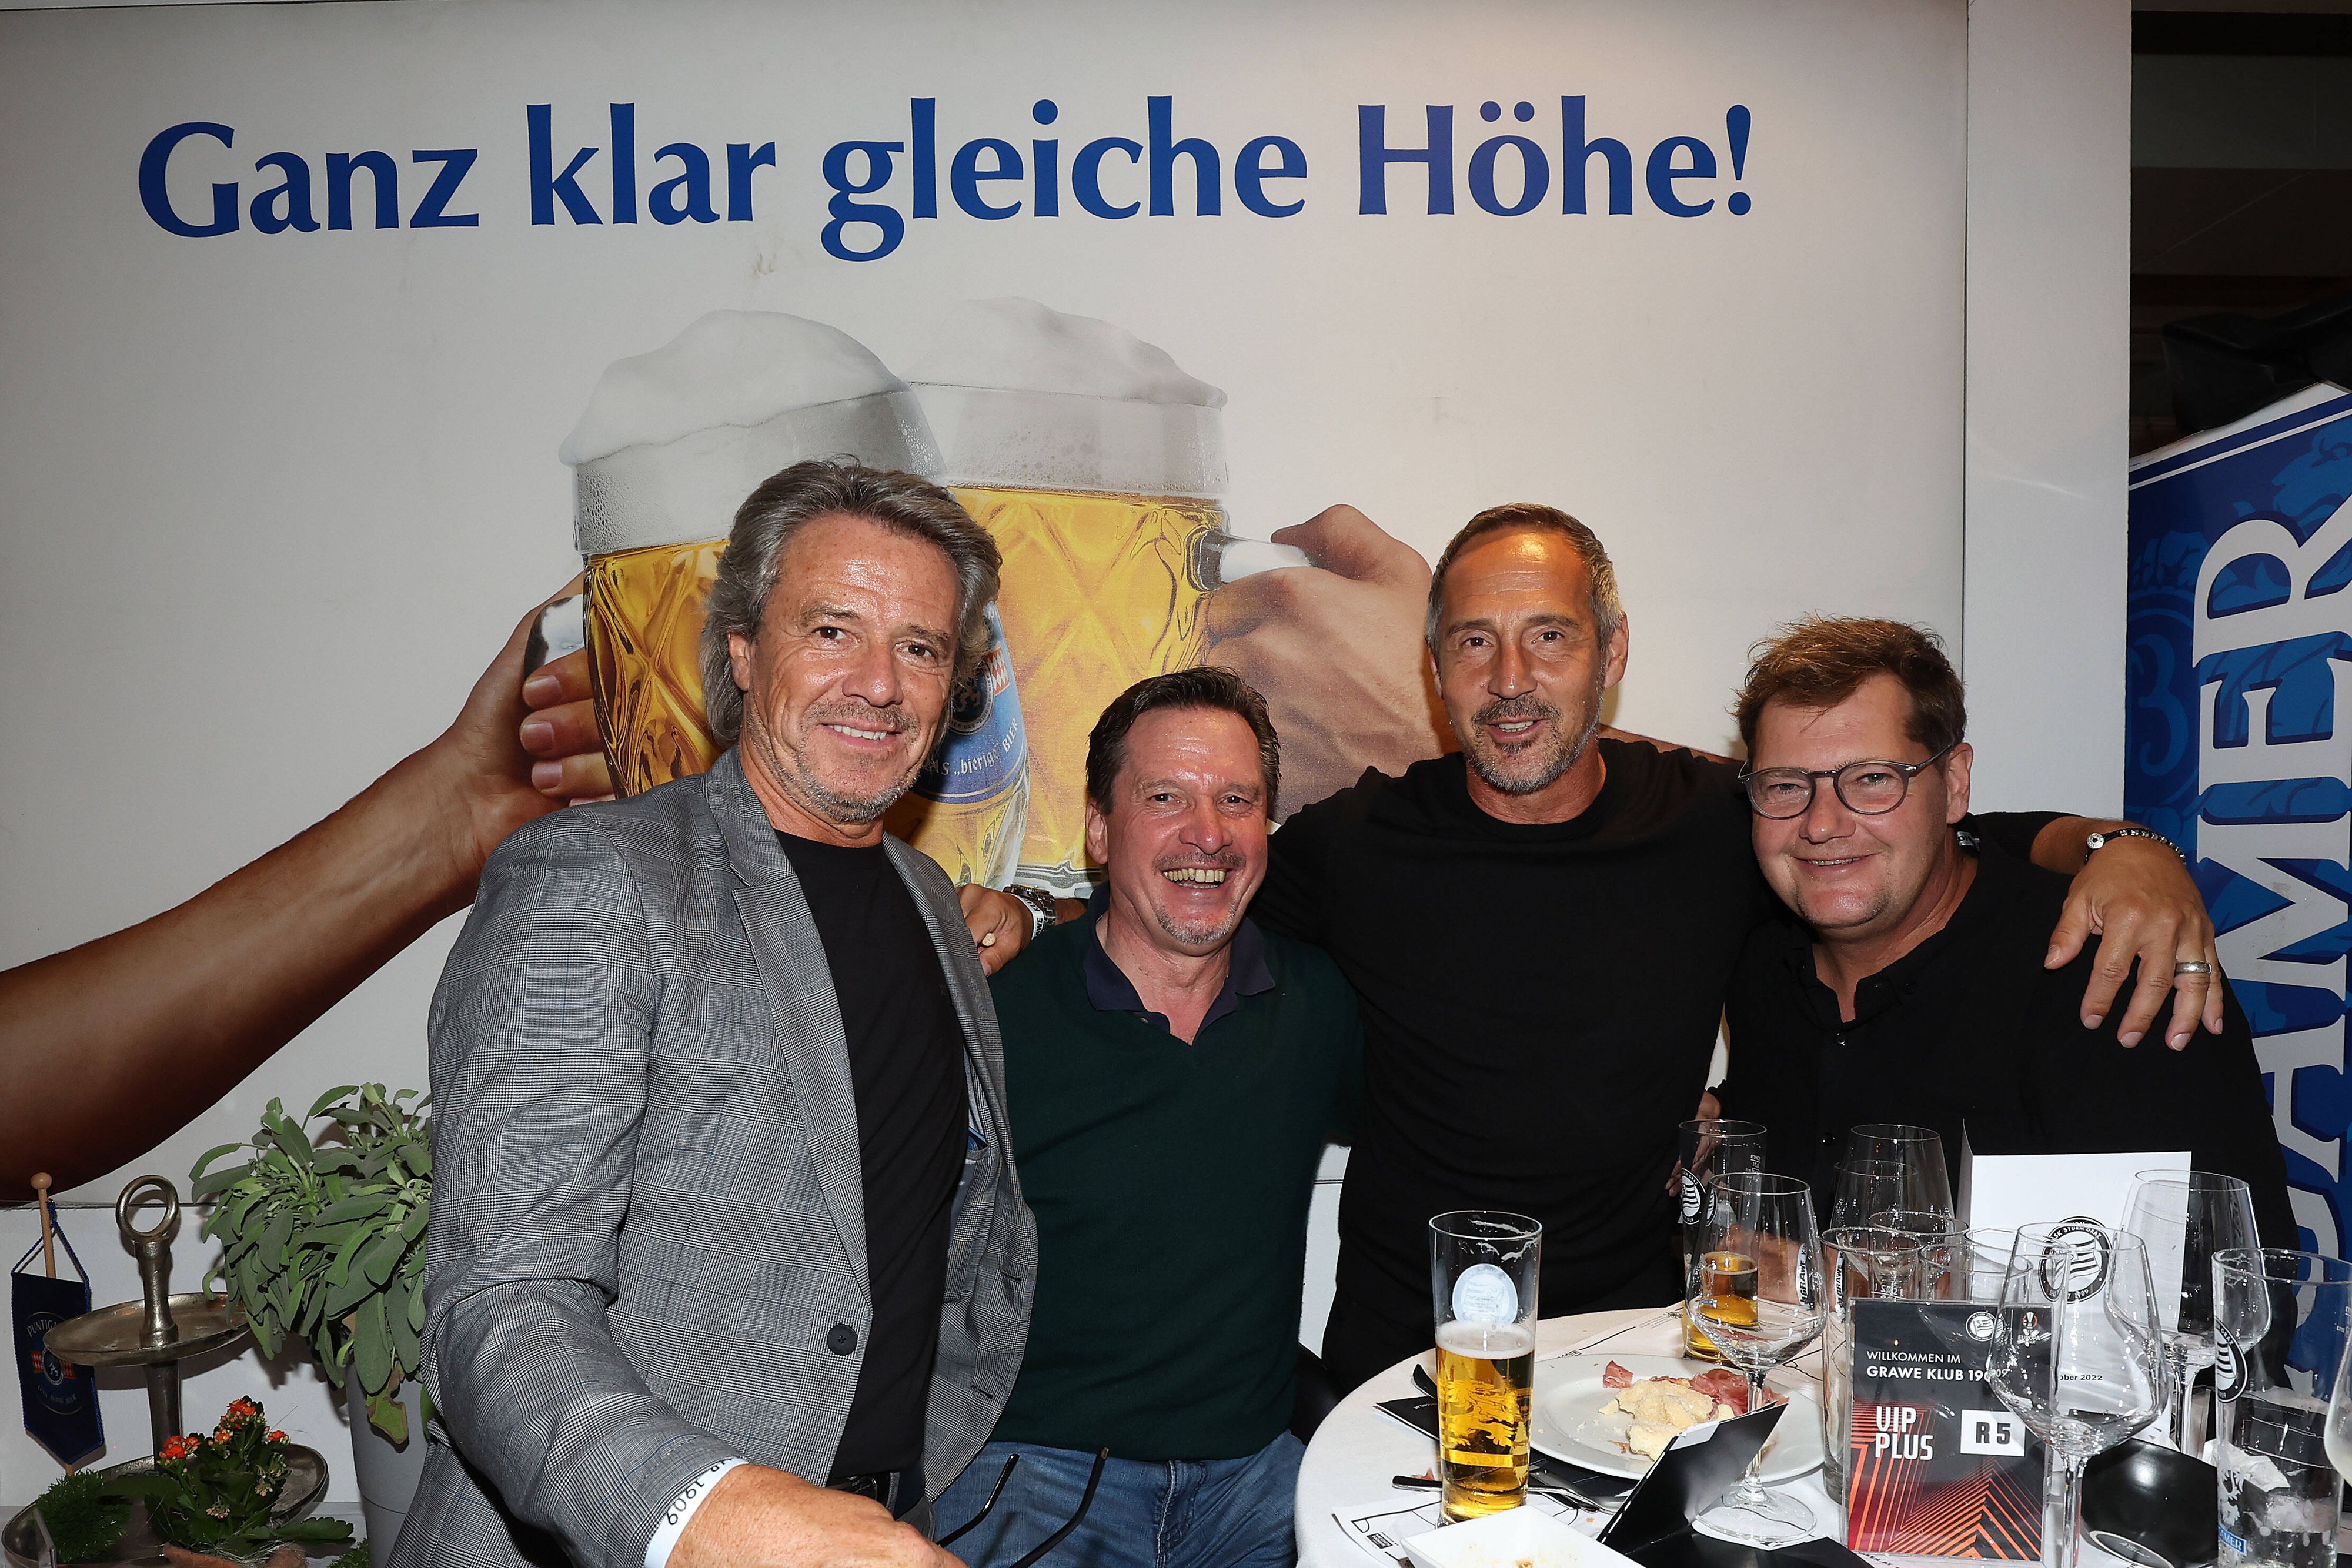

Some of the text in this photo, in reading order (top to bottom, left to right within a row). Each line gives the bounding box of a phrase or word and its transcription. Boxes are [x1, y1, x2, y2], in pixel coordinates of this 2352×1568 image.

[139, 95, 1752, 262] Ganz klar gleiche Höhe!
[1001, 718, 1019, 753] BIER
[2053, 1230, 2063, 1239] SK
[2086, 1228, 2102, 1239] GRAZ
[26, 1319, 57, 1338] PUNTIG
[1866, 1350, 1961, 1363] WILLKOMMEN IM
[1866, 1365, 1922, 1379] GRAWE
[1927, 1368, 1965, 1381] KLUB
[1876, 1405, 1917, 1433] VIP
[1875, 1432, 1934, 1461] PLUS
